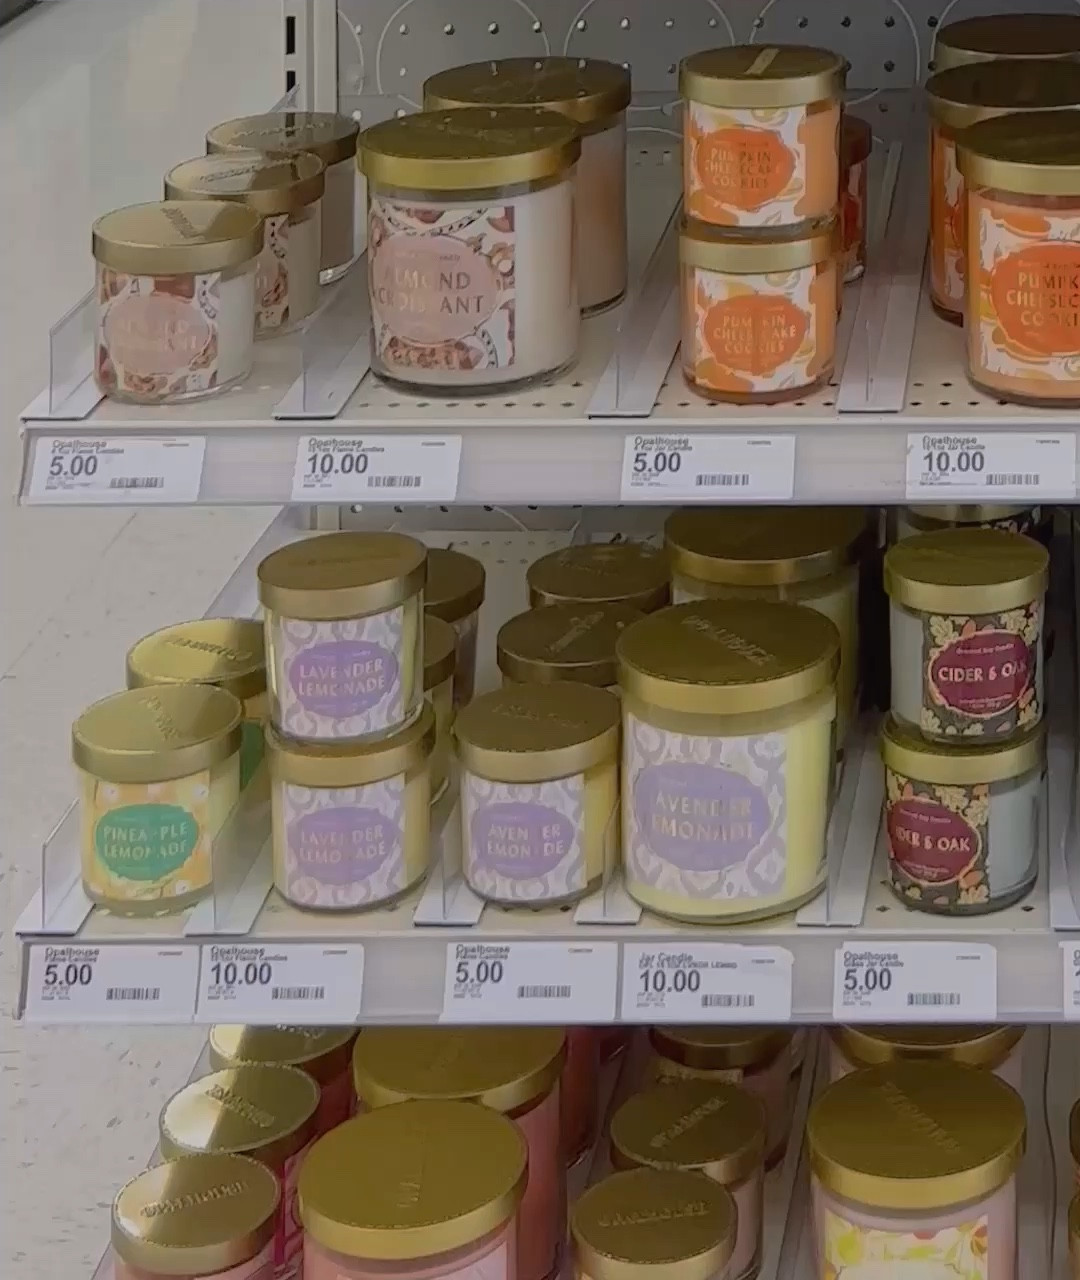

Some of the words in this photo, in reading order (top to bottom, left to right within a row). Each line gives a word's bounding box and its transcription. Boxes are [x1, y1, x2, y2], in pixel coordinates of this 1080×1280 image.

[378, 285, 484, 314] CROISANT
[722, 313, 785, 330] PUMKIN
[49, 453, 98, 476] 5.00
[307, 453, 369, 474] 10.00
[632, 452, 681, 473] 5.00
[922, 450, 985, 472] 10.00
[298, 656, 384, 681] LAVENDER
[937, 665, 984, 683] CIDER
[987, 665, 998, 682] &
[102, 821, 189, 844] PINEAPLE
[892, 824, 922, 849] IDER
[923, 833, 933, 850] &
[936, 835, 972, 854] OAK
[44, 963, 93, 986] 5.00
[210, 962, 273, 986] 10.00
[455, 960, 504, 984] 5.00
[639, 969, 701, 993] 10.00
[844, 967, 892, 991] 5.00
